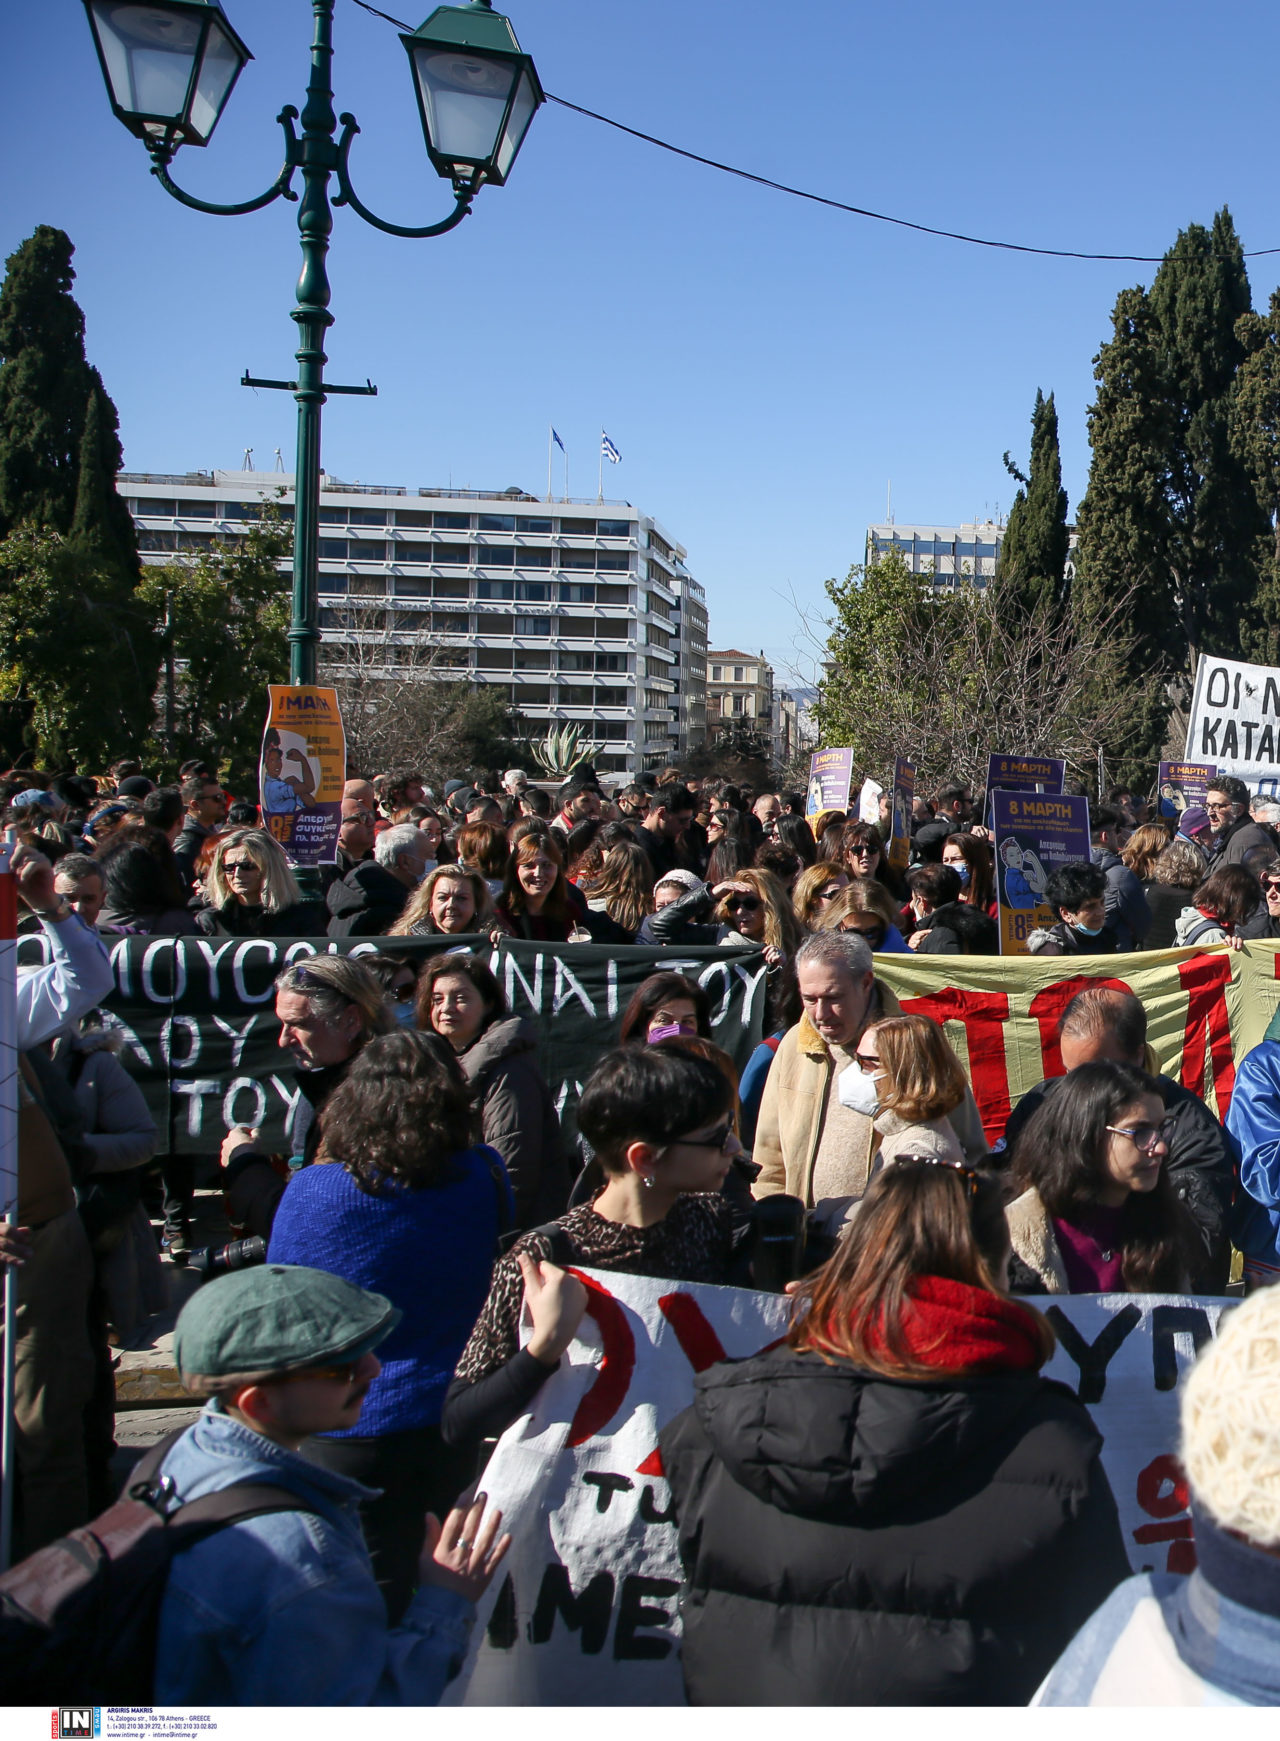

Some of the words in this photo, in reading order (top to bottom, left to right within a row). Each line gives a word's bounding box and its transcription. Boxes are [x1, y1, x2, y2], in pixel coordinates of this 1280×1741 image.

[1207, 667, 1241, 709] ΟΙ
[1001, 762, 1007, 771] 8
[1011, 763, 1051, 774] ΜΑΡΤΗ
[1169, 766, 1174, 774] 8
[1177, 767, 1208, 776] ΜΑΡΤΗ
[1009, 801, 1019, 815] 8
[1023, 801, 1072, 818] ΜΑΡΤΗ
[1015, 914, 1027, 941] 8
